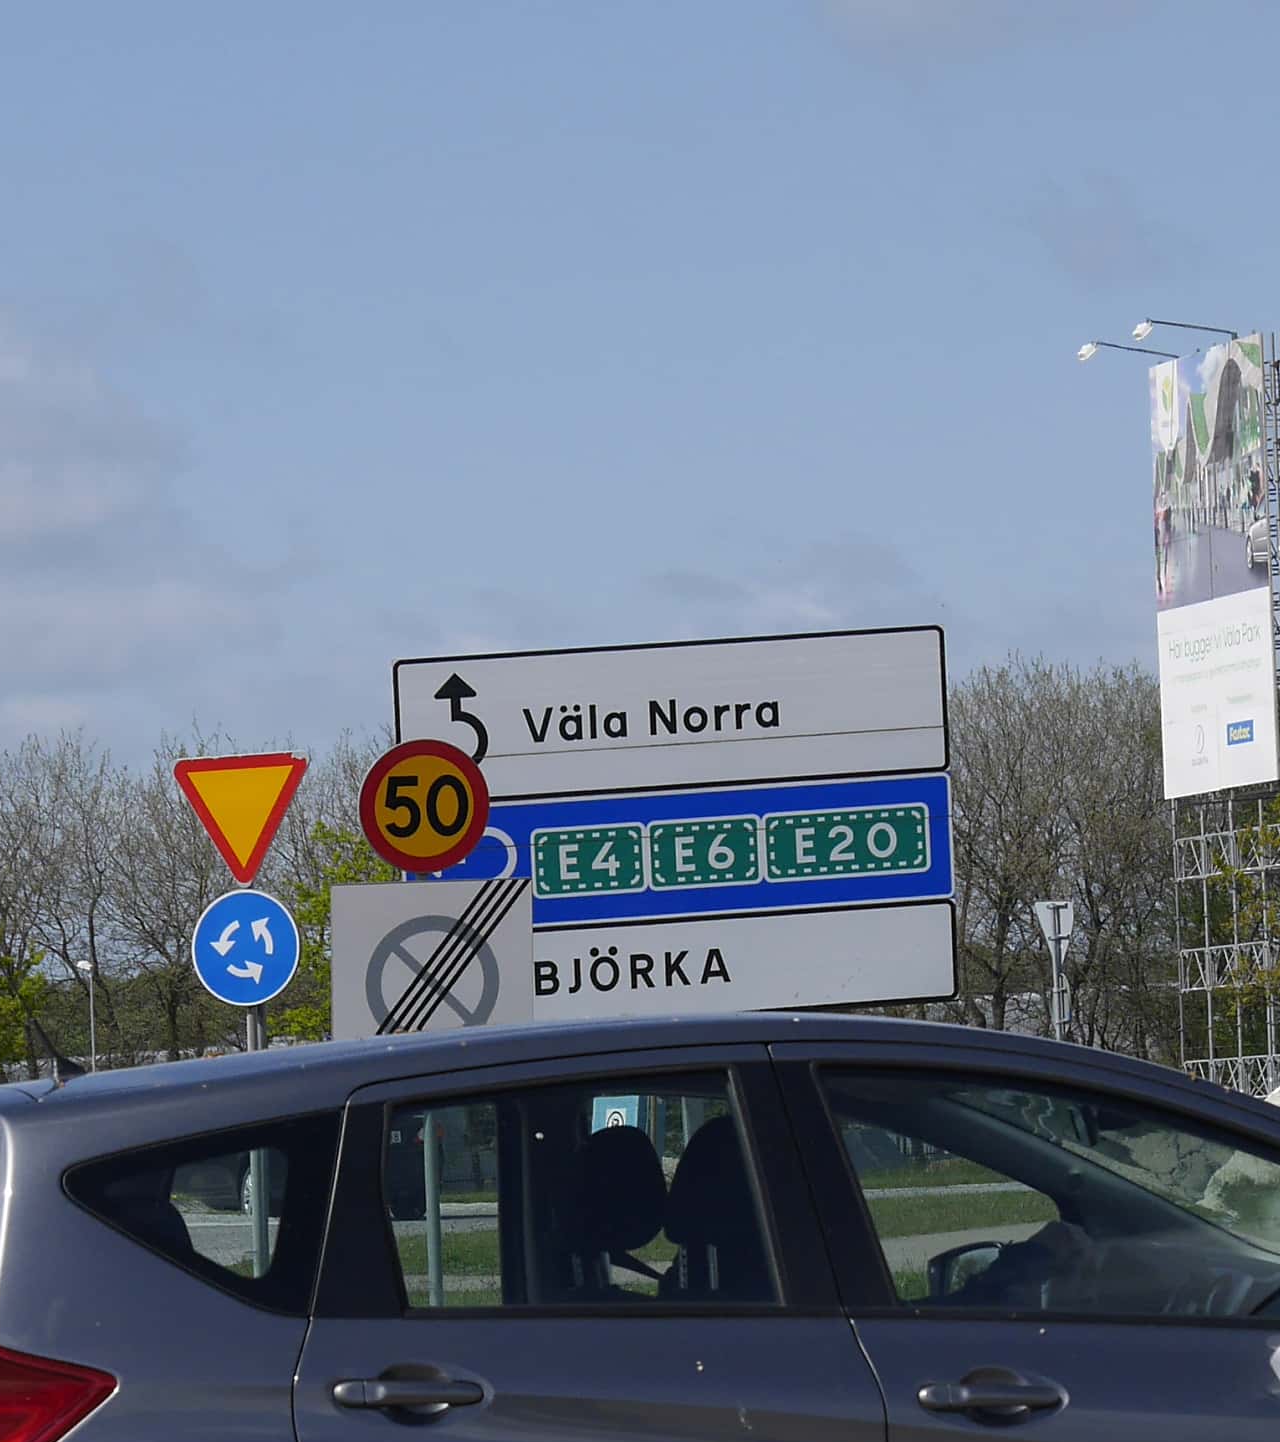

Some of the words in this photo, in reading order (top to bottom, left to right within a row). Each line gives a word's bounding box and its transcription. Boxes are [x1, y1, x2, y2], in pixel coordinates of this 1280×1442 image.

[522, 703, 629, 744] Väla
[647, 697, 781, 737] Norra
[384, 774, 469, 838] 50
[558, 840, 621, 881] E4
[674, 832, 736, 874] E6
[795, 821, 899, 865] E20
[533, 945, 732, 997] BJÖRKA
